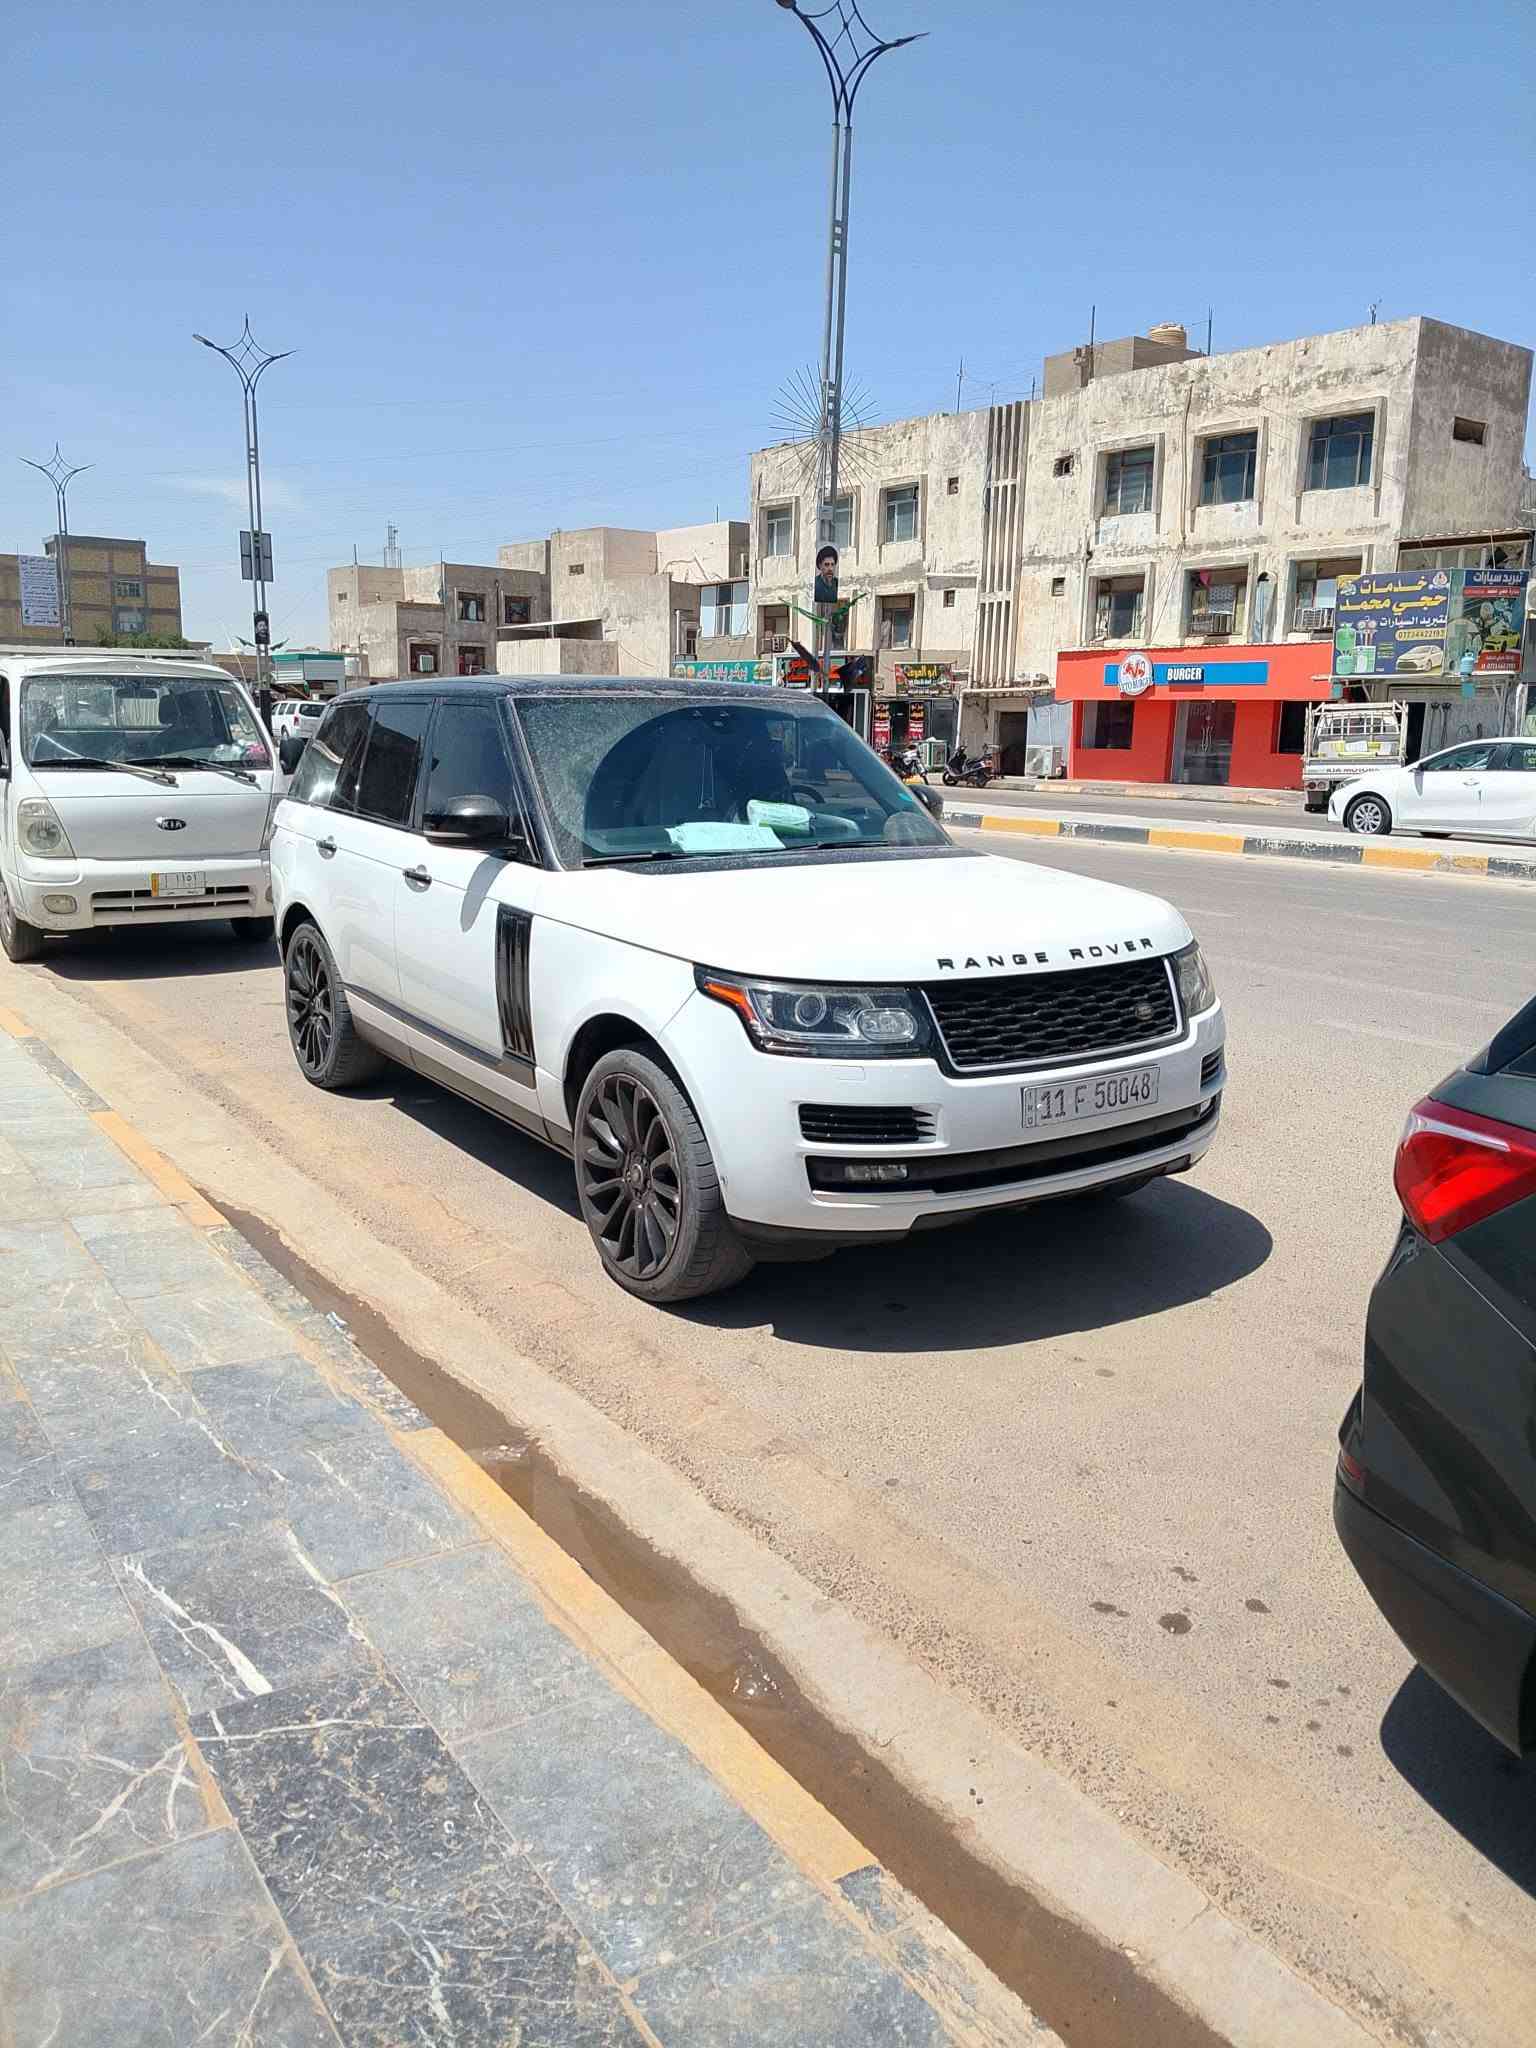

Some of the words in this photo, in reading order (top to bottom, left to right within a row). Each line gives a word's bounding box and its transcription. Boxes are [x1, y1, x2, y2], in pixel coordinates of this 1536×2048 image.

[1360, 575, 1427, 594] خدمات
[1340, 598, 1391, 611] محمد
[1392, 594, 1447, 616] حجي
[1167, 667, 1202, 681] BURGER
[160, 820, 184, 830] KIA
[937, 952, 1049, 970] RANGE
[1068, 938, 1153, 960] ROVER
[1041, 1089, 1066, 1119] 11
[1075, 1085, 1087, 1114] F
[1094, 1073, 1150, 1109] 50048
